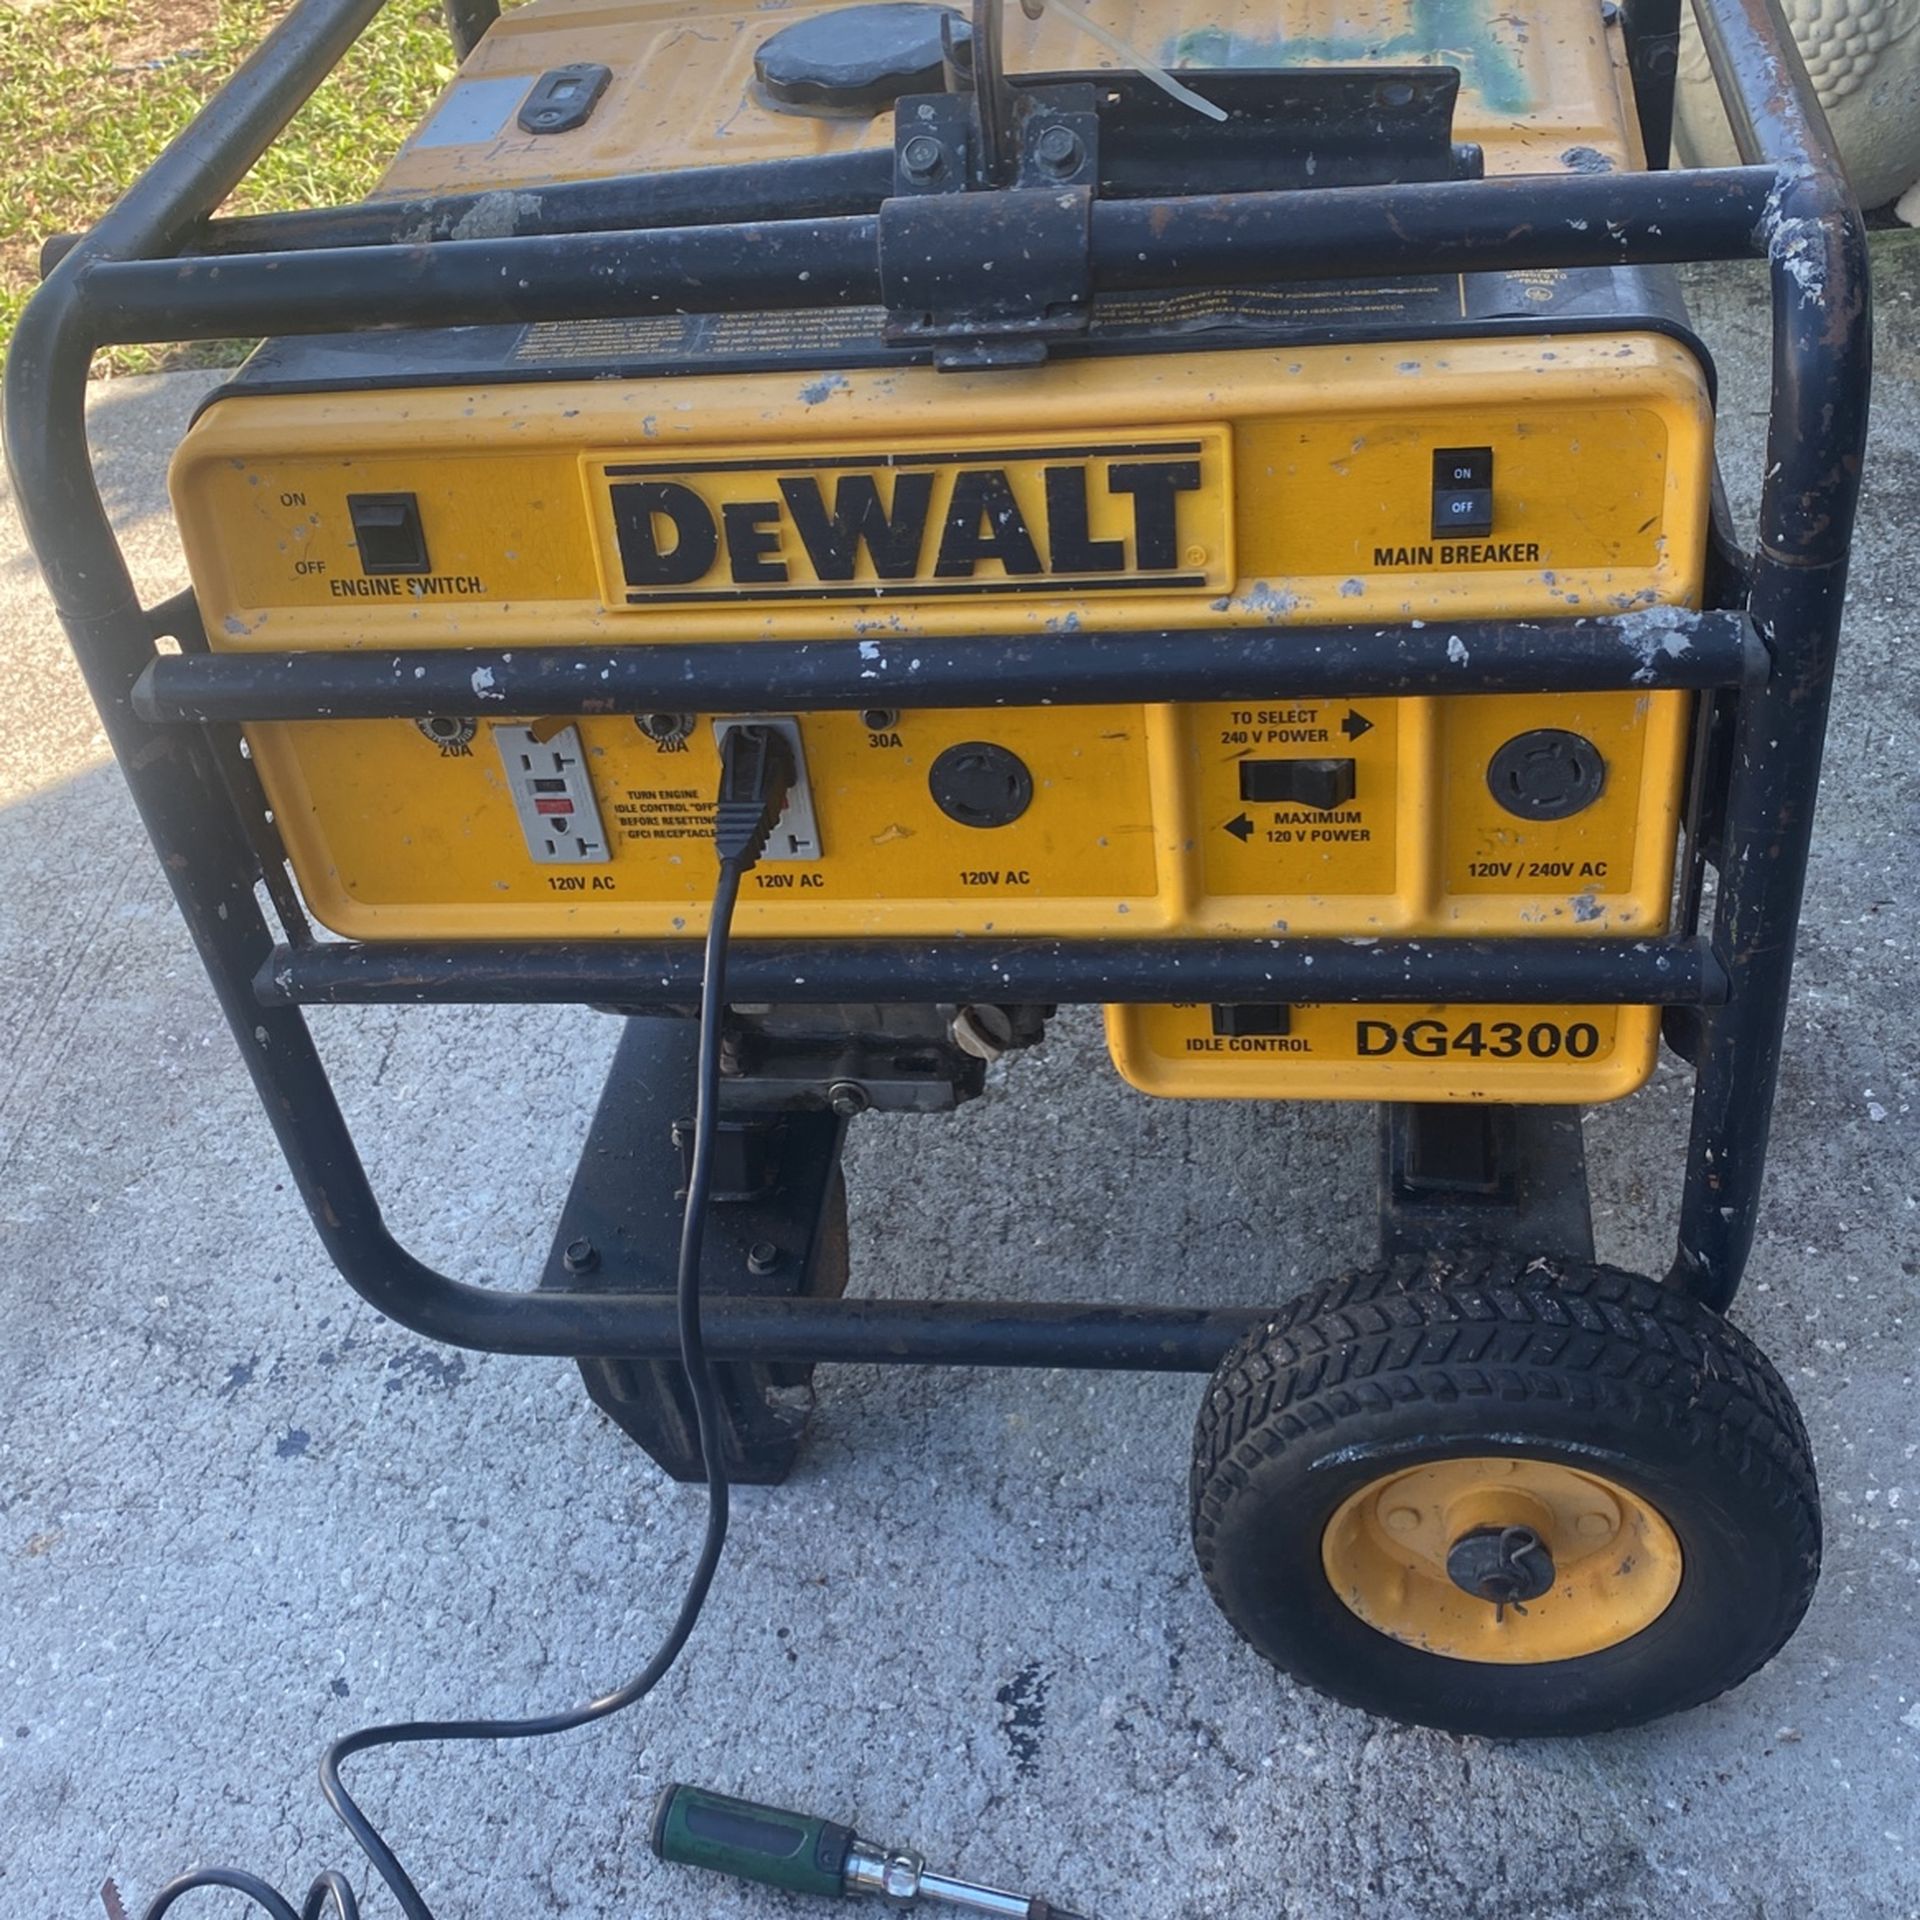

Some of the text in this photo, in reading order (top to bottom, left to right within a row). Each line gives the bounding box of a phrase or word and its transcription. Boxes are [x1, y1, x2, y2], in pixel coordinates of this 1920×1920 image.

[1453, 468, 1472, 479] ON
[280, 492, 306, 507] ON
[1451, 502, 1473, 513] OFF
[1373, 543, 1539, 566] MAIN BREAKER
[295, 561, 326, 575] OFF
[330, 576, 481, 597] ENGINE SWITCH
[1231, 710, 1318, 725] TO SELECT
[868, 733, 903, 748] 30A
[1221, 729, 1329, 744] 240 V POWER
[626, 790, 700, 800] TURN ENGINE
[614, 803, 638, 813] IDLE
[639, 803, 689, 813] CONTROL
[620, 816, 660, 826] BEFORE
[1274, 812, 1361, 825] MAXIMUM
[628, 830, 652, 839] GFCI
[1266, 829, 1371, 843] 120 V POWER
[1468, 862, 1513, 877] 120V
[1529, 862, 1575, 877] 240V
[1579, 861, 1608, 876] AC
[548, 876, 615, 890] 120V AC
[756, 874, 824, 888] 120V AC
[960, 870, 1030, 885] 120V AC
[1186, 1038, 1314, 1052] IDLE CONTROL
[1356, 1020, 1600, 1059] DG4300
